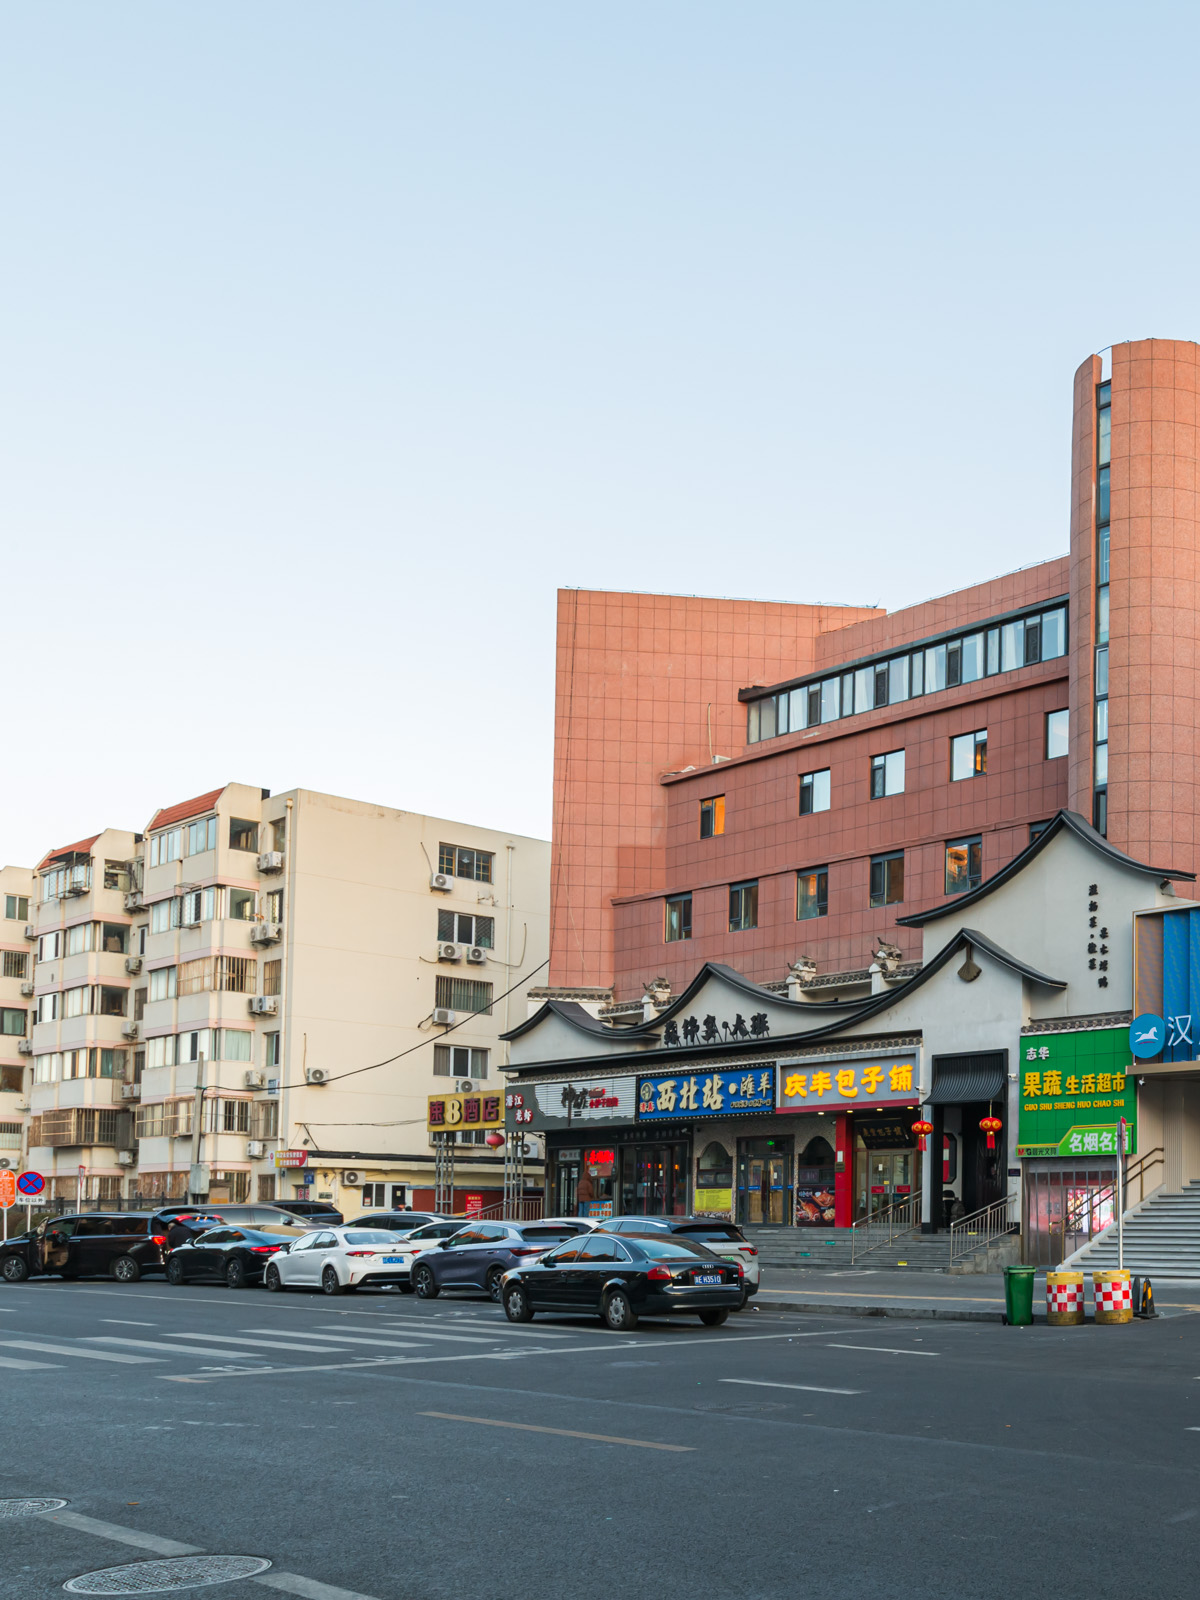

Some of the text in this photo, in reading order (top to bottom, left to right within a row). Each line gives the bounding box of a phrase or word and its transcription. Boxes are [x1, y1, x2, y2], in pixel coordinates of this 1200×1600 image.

[1026, 1046, 1049, 1060] 志华
[784, 1064, 913, 1098] 庆丰包子铺
[429, 1097, 500, 1125] 速8酒店
[1024, 1099, 1124, 1111] GUO SHU SHENG HUO CHAO SHI
